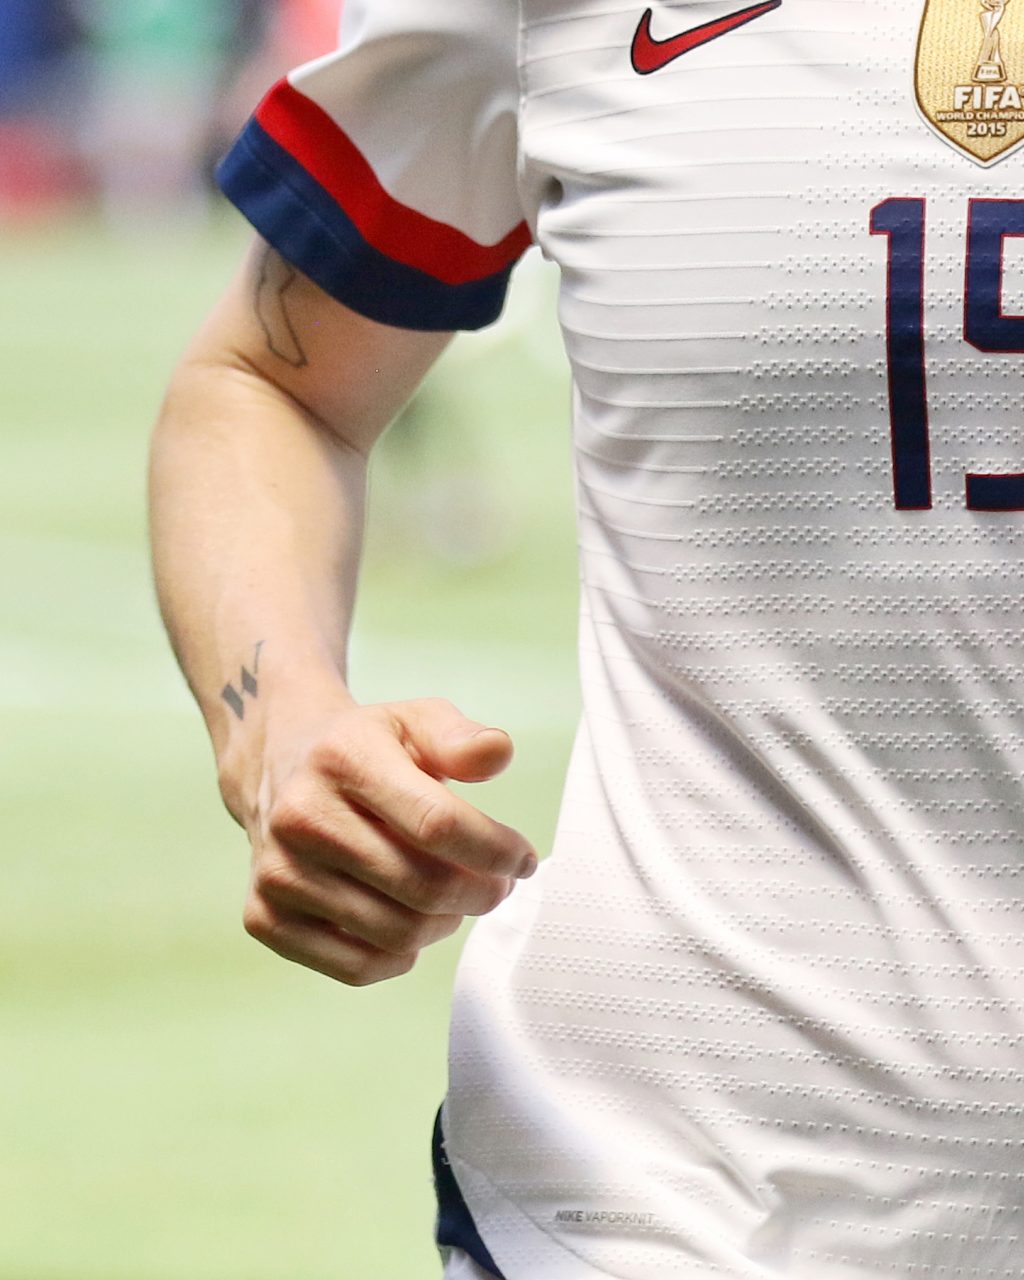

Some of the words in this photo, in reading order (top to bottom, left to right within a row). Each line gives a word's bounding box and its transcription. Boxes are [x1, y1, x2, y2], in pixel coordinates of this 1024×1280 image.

[954, 85, 1021, 110] FIFA
[936, 111, 973, 120] WORLD
[967, 122, 1006, 136] 2015
[555, 1210, 583, 1222] NIKE
[585, 1211, 656, 1225] VAPORKNIT
